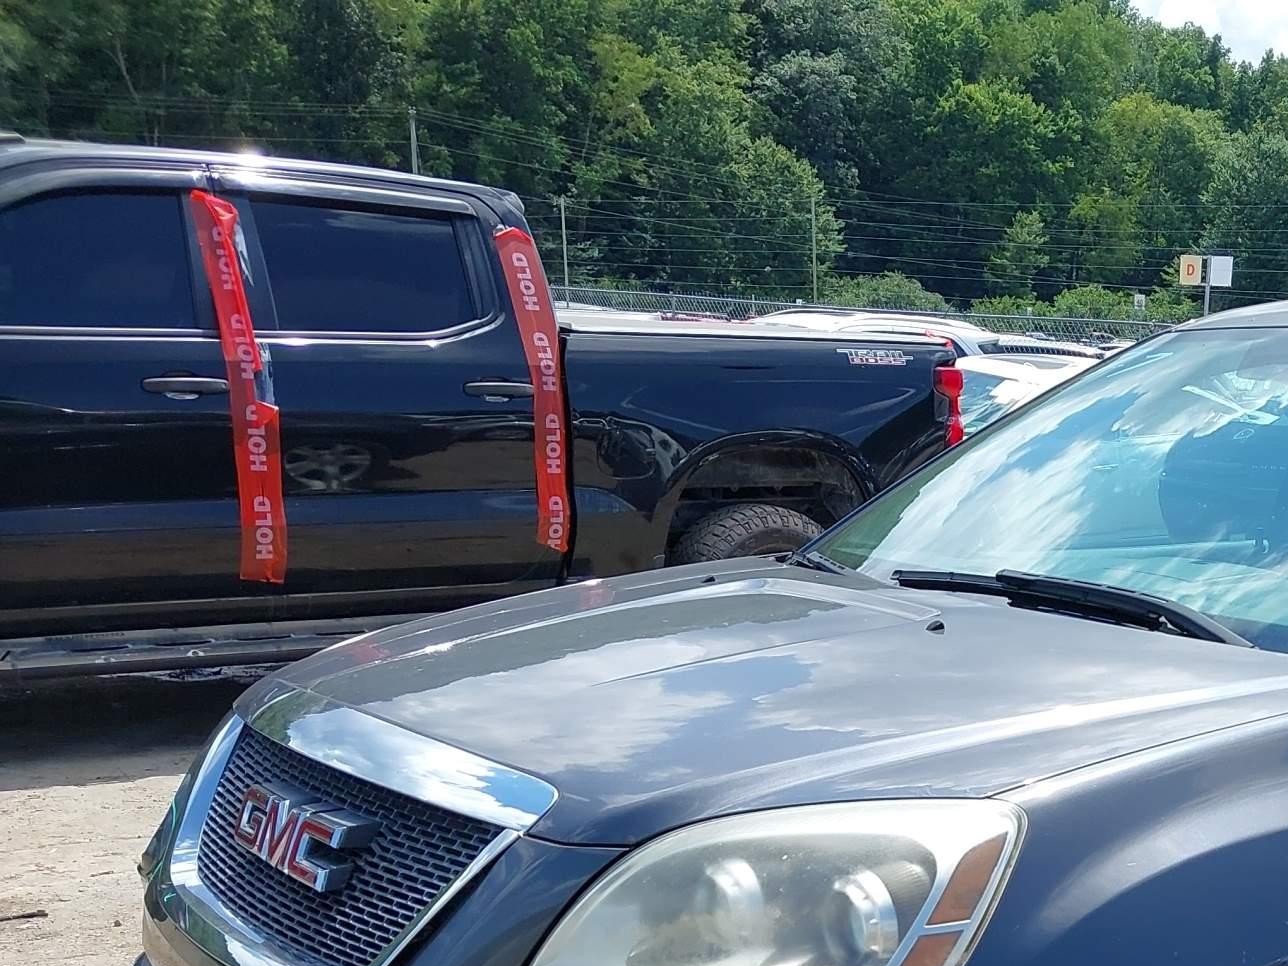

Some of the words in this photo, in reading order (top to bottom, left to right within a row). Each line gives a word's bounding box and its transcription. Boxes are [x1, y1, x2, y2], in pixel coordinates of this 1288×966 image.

[511, 252, 540, 311] HOLD
[1186, 263, 1195, 276] D
[533, 331, 557, 391] HOLD
[836, 348, 914, 360] TRAIL
[545, 413, 561, 474] HOLD
[254, 495, 274, 560] HOLD
[234, 783, 349, 893] GMC
